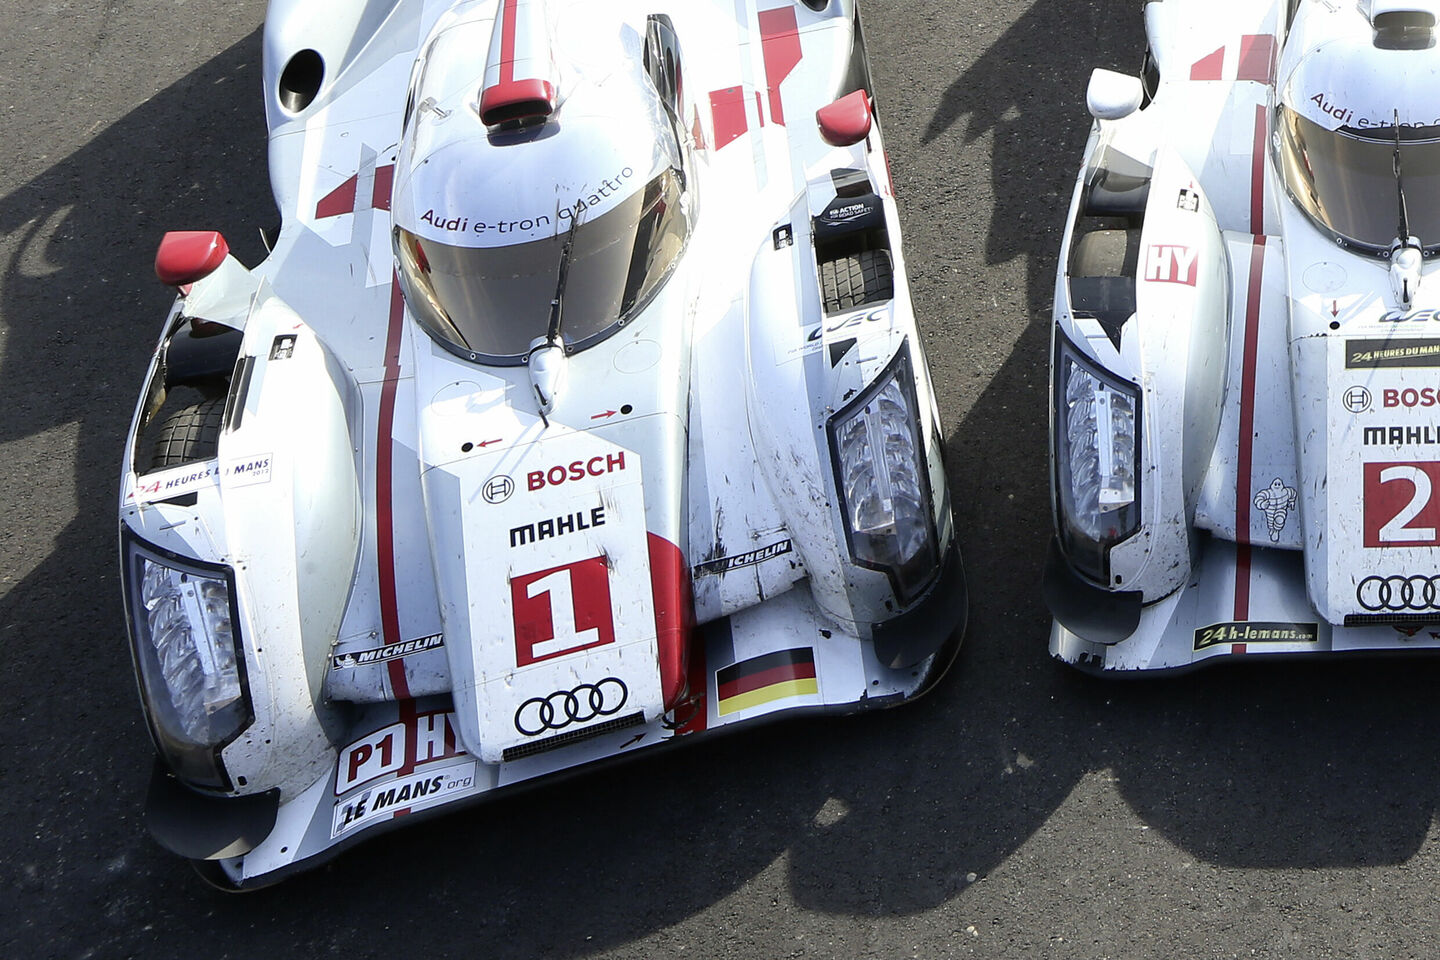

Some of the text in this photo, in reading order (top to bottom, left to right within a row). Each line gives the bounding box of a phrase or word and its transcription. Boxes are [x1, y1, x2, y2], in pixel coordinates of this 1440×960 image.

[1310, 92, 1354, 124] Audi
[420, 166, 634, 234] Audi e-tron quattro
[840, 203, 865, 213] ACTION
[1147, 245, 1198, 285] HY
[1351, 351, 1373, 363] 24
[1373, 348, 1405, 359] HEURES
[1405, 347, 1419, 356] DU
[165, 468, 210, 490] HEURES
[233, 458, 270, 475] MANS
[527, 451, 626, 492] BOSCH
[1378, 465, 1437, 543] 2
[510, 506, 606, 547] MAHLE
[526, 567, 599, 659] 1
[357, 634, 443, 663] MICHELIN
[347, 734, 395, 784] P1
[344, 796, 368, 827] LE
[372, 775, 443, 813] MANS
